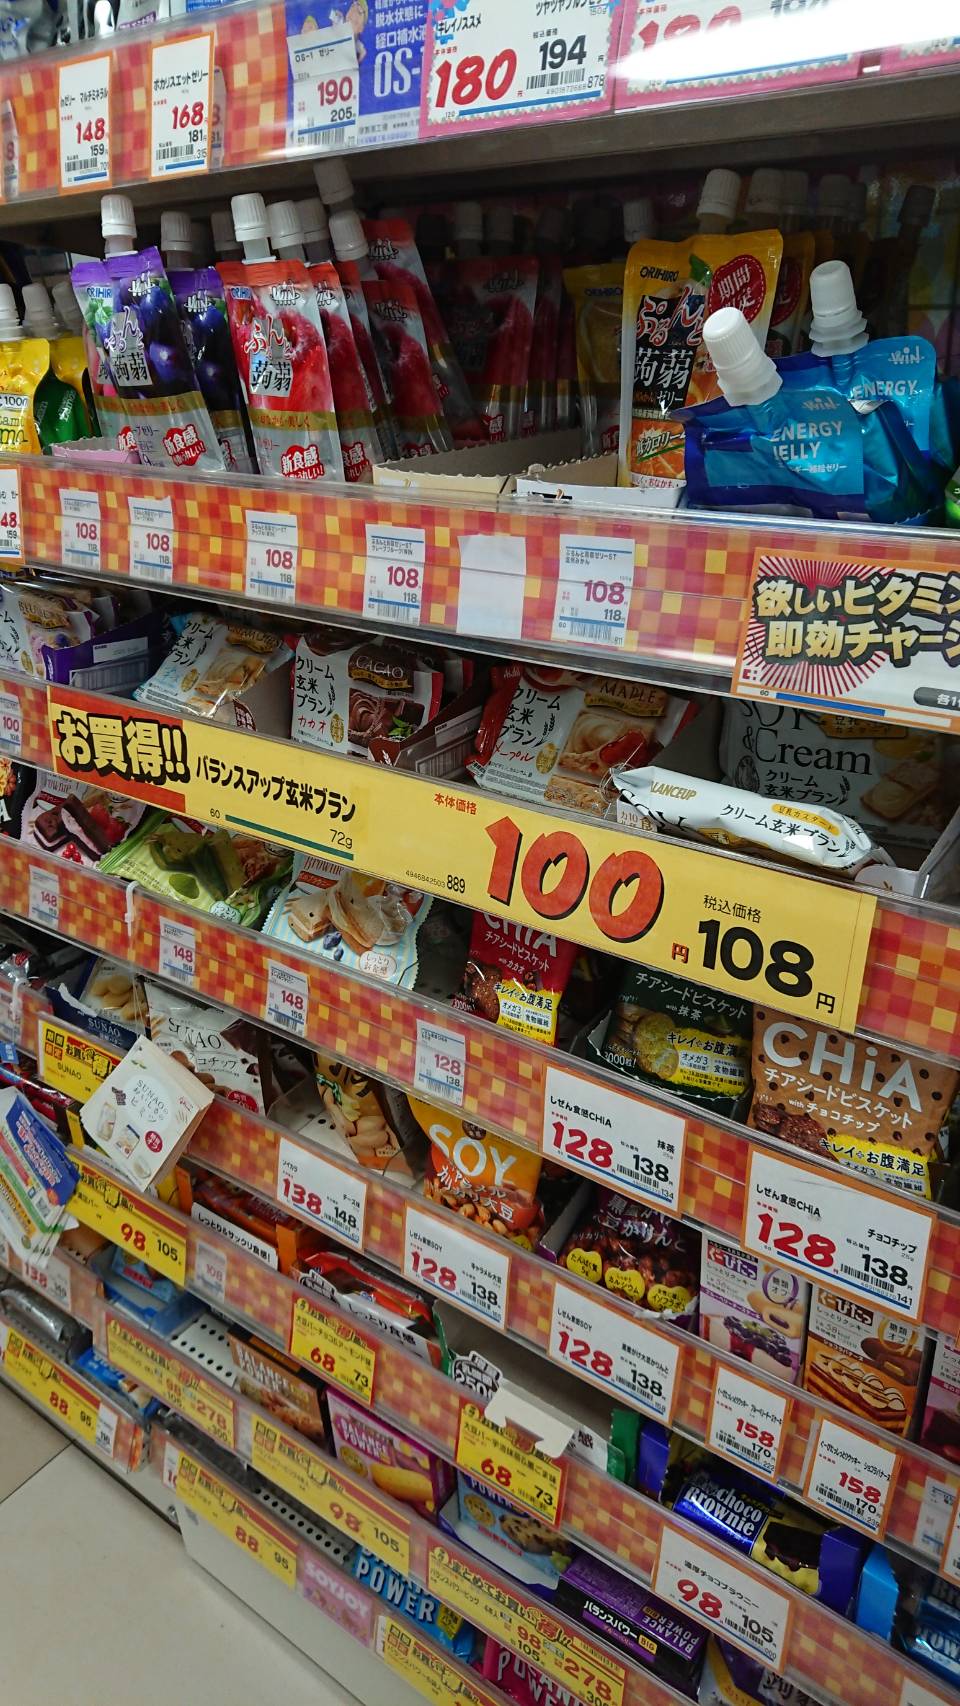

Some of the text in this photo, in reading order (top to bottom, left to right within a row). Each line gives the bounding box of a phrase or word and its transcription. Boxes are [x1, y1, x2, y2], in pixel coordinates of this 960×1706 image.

[438, 13, 482, 36] キレイノススメ
[319, 48, 336, 57] ゼリー
[539, 35, 586, 71] 194
[436, 49, 517, 108] 180
[587, 74, 604, 90] 878
[317, 76, 353, 107] 190
[171, 102, 205, 130] 168
[330, 107, 353, 122] 205
[76, 117, 106, 145] 148
[188, 129, 204, 143] 181
[90, 143, 105, 157] 159
[640, 266, 679, 282] ORIHIRO
[851, 379, 918, 400] ENERGY
[163, 424, 200, 455] 新食感
[770, 421, 843, 443] ENERGY
[281, 445, 319, 475] 新食感
[773, 441, 821, 460] JELLY
[6, 530, 18, 540] 159
[76, 522, 98, 540] 108
[146, 532, 170, 552] 108
[158, 555, 170, 565] 118
[265, 548, 293, 570] 108
[279, 572, 292, 584] 118
[387, 566, 420, 589] 108
[403, 592, 418, 603] 118
[584, 579, 626, 605] 108
[604, 608, 622, 621] 118
[295, 655, 336, 681] クリーム
[355, 654, 405, 679] CACAO
[295, 674, 319, 694] 玄米
[601, 680, 657, 703] MAPLE
[296, 693, 327, 715] ブラン
[512, 687, 561, 711] クリーム
[3, 715, 20, 732] 100
[297, 713, 327, 733] カカオ
[504, 704, 533, 724] 玄米
[58, 712, 189, 784] お買得!!
[498, 725, 537, 747] ブラン
[755, 724, 873, 776] Cream
[196, 754, 356, 823] バランスアップ玄米ブラン
[765, 769, 819, 788] クリーム
[433, 793, 477, 815] 本体価格
[763, 783, 838, 805] 玄米ブラン
[210, 808, 221, 819] 60
[329, 828, 353, 849] 72g
[720, 803, 840, 857] クリーム玄米ブラン
[446, 874, 466, 894] 889
[485, 815, 664, 943] 100
[40, 890, 58, 908] 148
[703, 894, 762, 924] 税込価格
[173, 944, 194, 963] 148
[484, 931, 550, 973] チアシードビスケット
[671, 942, 690, 964] 円
[698, 918, 836, 1015] 108 円
[281, 989, 304, 1011] 148
[635, 972, 748, 1020] チアシードビスケット
[290, 1009, 303, 1020] 159
[678, 1005, 702, 1021] 抹茶
[88, 1017, 121, 1038] SUNAO
[168, 1016, 223, 1050] SUNAO
[57, 1061, 82, 1080] SUNAO
[434, 1053, 462, 1076] 128
[681, 1052, 708, 1065] オメガ3
[763, 1022, 923, 1113] CHiA
[445, 1074, 462, 1087] 138
[763, 1067, 913, 1129] チアシードビスケット
[550, 1095, 612, 1129] しぜん食感CHiA
[788, 1098, 880, 1134] with チョコチップ
[428, 1122, 517, 1186] SOY
[552, 1120, 614, 1169] 128
[657, 1138, 676, 1155] 抹茶
[632, 1152, 670, 1183] 138
[283, 1176, 322, 1215] 138
[660, 1187, 675, 1201] 134
[756, 1183, 822, 1218] しぜん食感CHiA
[333, 1205, 358, 1229] 148
[120, 1223, 147, 1252] 98
[157, 1238, 178, 1260] 105
[757, 1212, 837, 1268] 128
[867, 1228, 918, 1255] チョコチップ
[24, 1263, 48, 1287] 138
[206, 1263, 223, 1283] 108
[411, 1250, 457, 1292] 128
[861, 1253, 909, 1289] 138
[471, 1281, 498, 1306] 138
[896, 1293, 913, 1306] 141
[310, 1346, 336, 1374] 68
[558, 1331, 613, 1378] 128
[353, 1369, 370, 1386] 73
[630, 1368, 664, 1397] 138
[49, 1390, 68, 1416] 88
[195, 1399, 228, 1430] 278
[79, 1410, 92, 1428] 95
[736, 1417, 775, 1449] 158
[751, 1441, 772, 1459] 170
[480, 1457, 513, 1487] 68
[534, 1485, 554, 1506] 73
[839, 1470, 882, 1504] 158
[684, 1485, 756, 1537] Brownie
[717, 1486, 762, 1523] choco
[854, 1496, 878, 1515] 170
[329, 1501, 361, 1533] 98
[235, 1524, 259, 1553] 88
[373, 1526, 400, 1553] 105
[273, 1551, 290, 1570] 95
[304, 1560, 371, 1618] SOYJOY
[355, 1555, 435, 1623] POWER
[684, 1559, 760, 1609] 濃厚チョコブラウニー
[676, 1577, 724, 1620] 98
[583, 1599, 638, 1639] バランスパワー
[640, 1635, 656, 1651] BIG
[642, 1614, 694, 1654] BALANCE
[658, 1613, 700, 1644] POWER
[741, 1613, 776, 1644] 105
[516, 1624, 542, 1651] 98
[517, 1639, 541, 1662] 105
[563, 1656, 612, 1699] 278
